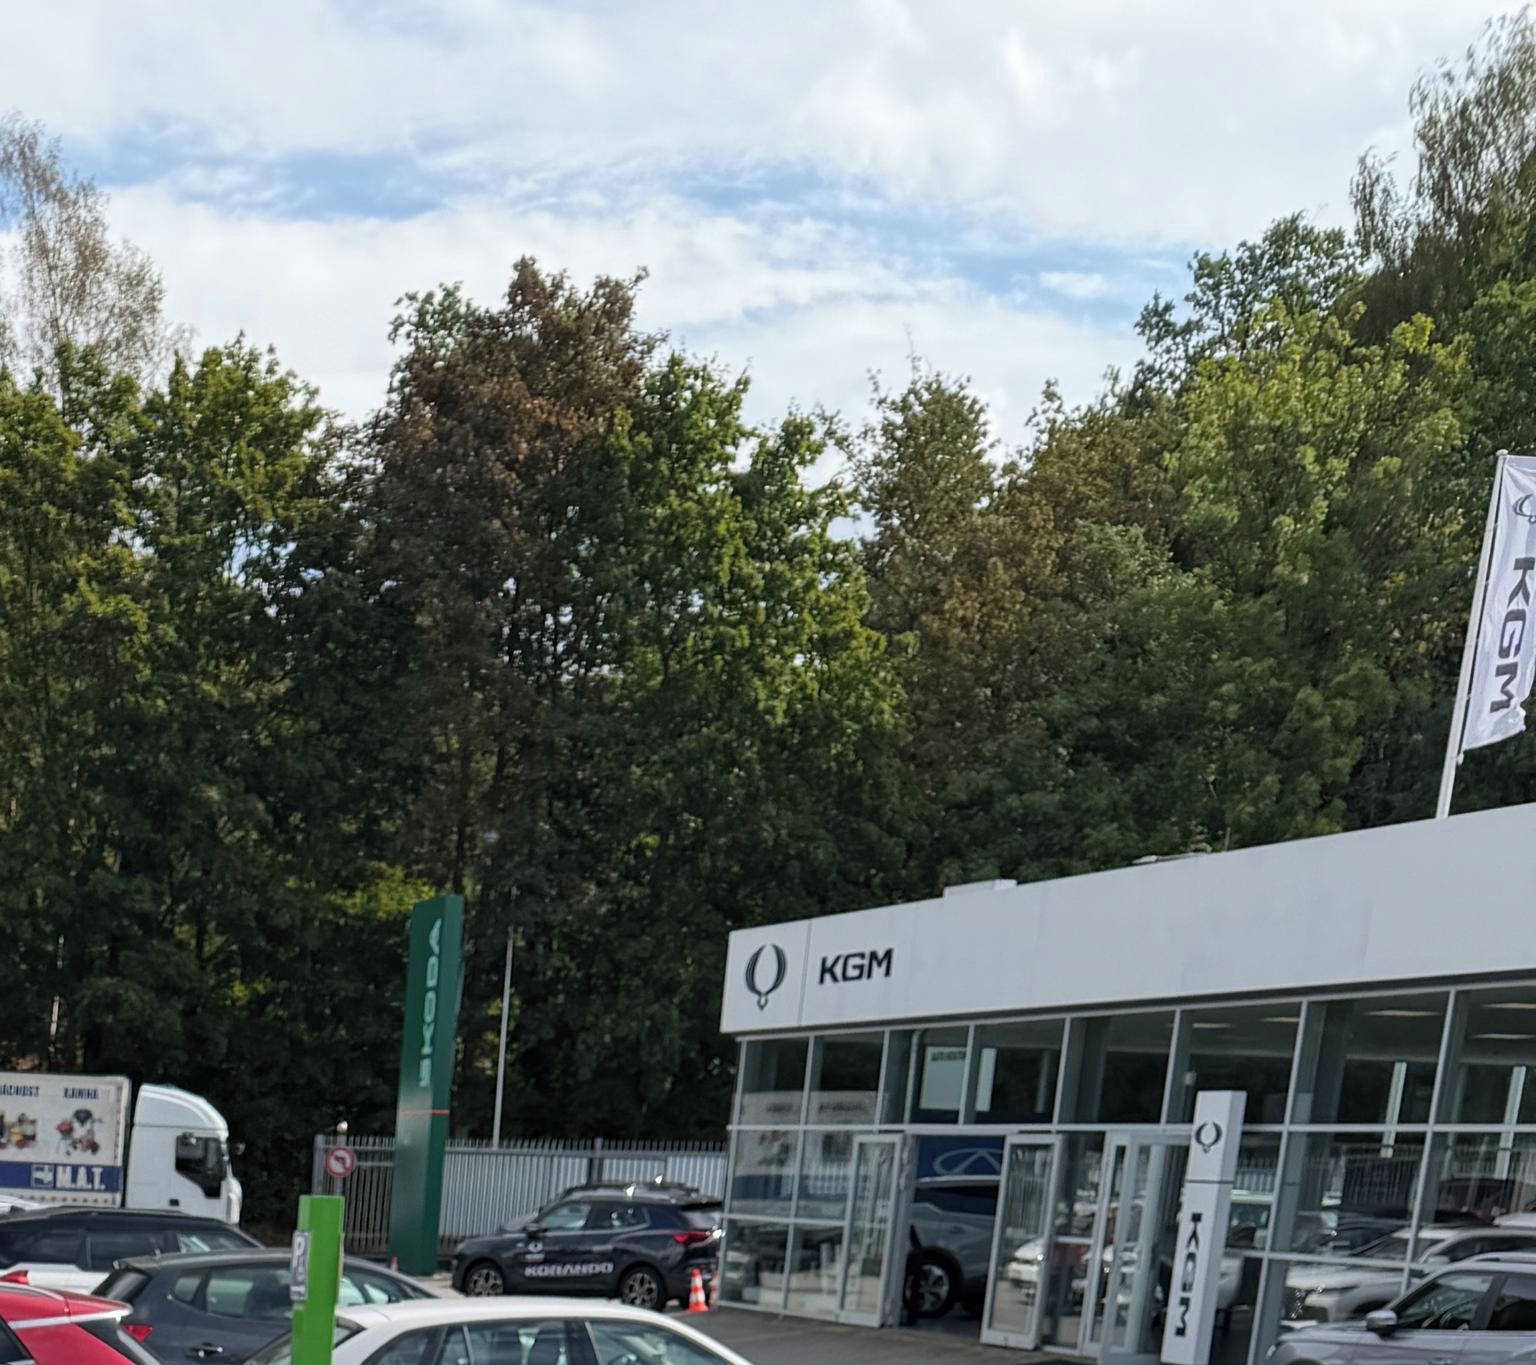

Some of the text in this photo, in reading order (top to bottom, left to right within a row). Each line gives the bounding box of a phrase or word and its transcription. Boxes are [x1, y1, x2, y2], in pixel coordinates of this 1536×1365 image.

[1490, 556, 1536, 714] KGM
[818, 947, 894, 985] KGM
[524, 1261, 614, 1278] KORANDO
[1175, 1212, 1203, 1337] KGM
